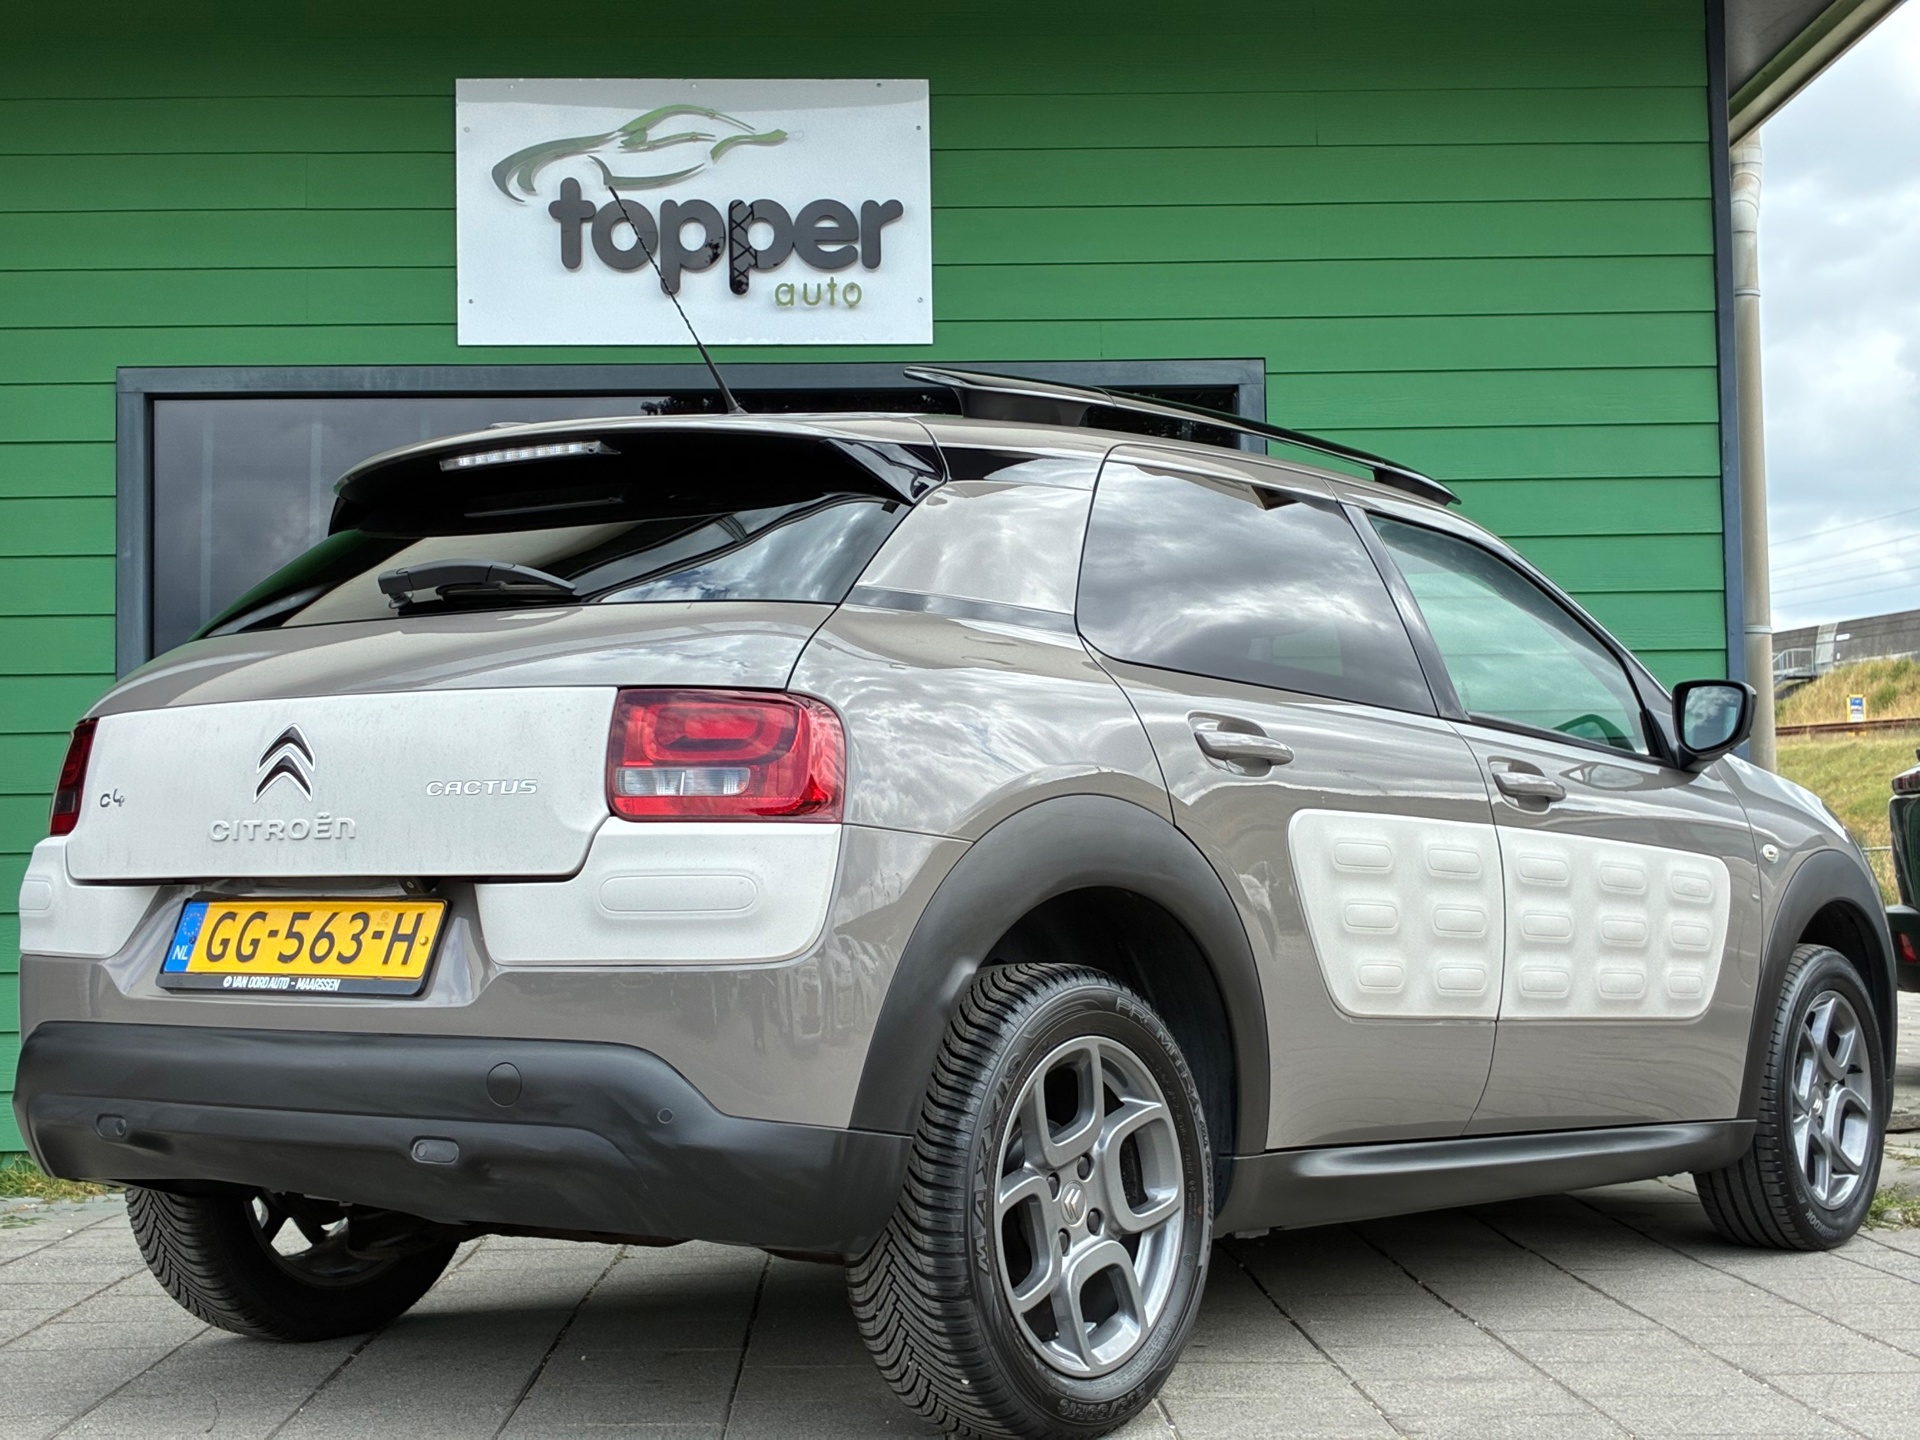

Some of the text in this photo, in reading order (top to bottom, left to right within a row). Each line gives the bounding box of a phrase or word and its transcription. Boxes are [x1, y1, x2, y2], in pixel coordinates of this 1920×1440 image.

[548, 177, 904, 295] topper
[774, 276, 863, 309] auto
[426, 779, 538, 796] CACTUS
[206, 911, 424, 966] GG-563-H
[171, 944, 188, 960] NL
[232, 976, 249, 988] VAN
[248, 976, 270, 989] OORD
[268, 977, 290, 989] AUTO
[295, 978, 341, 991] MAARSSEN
